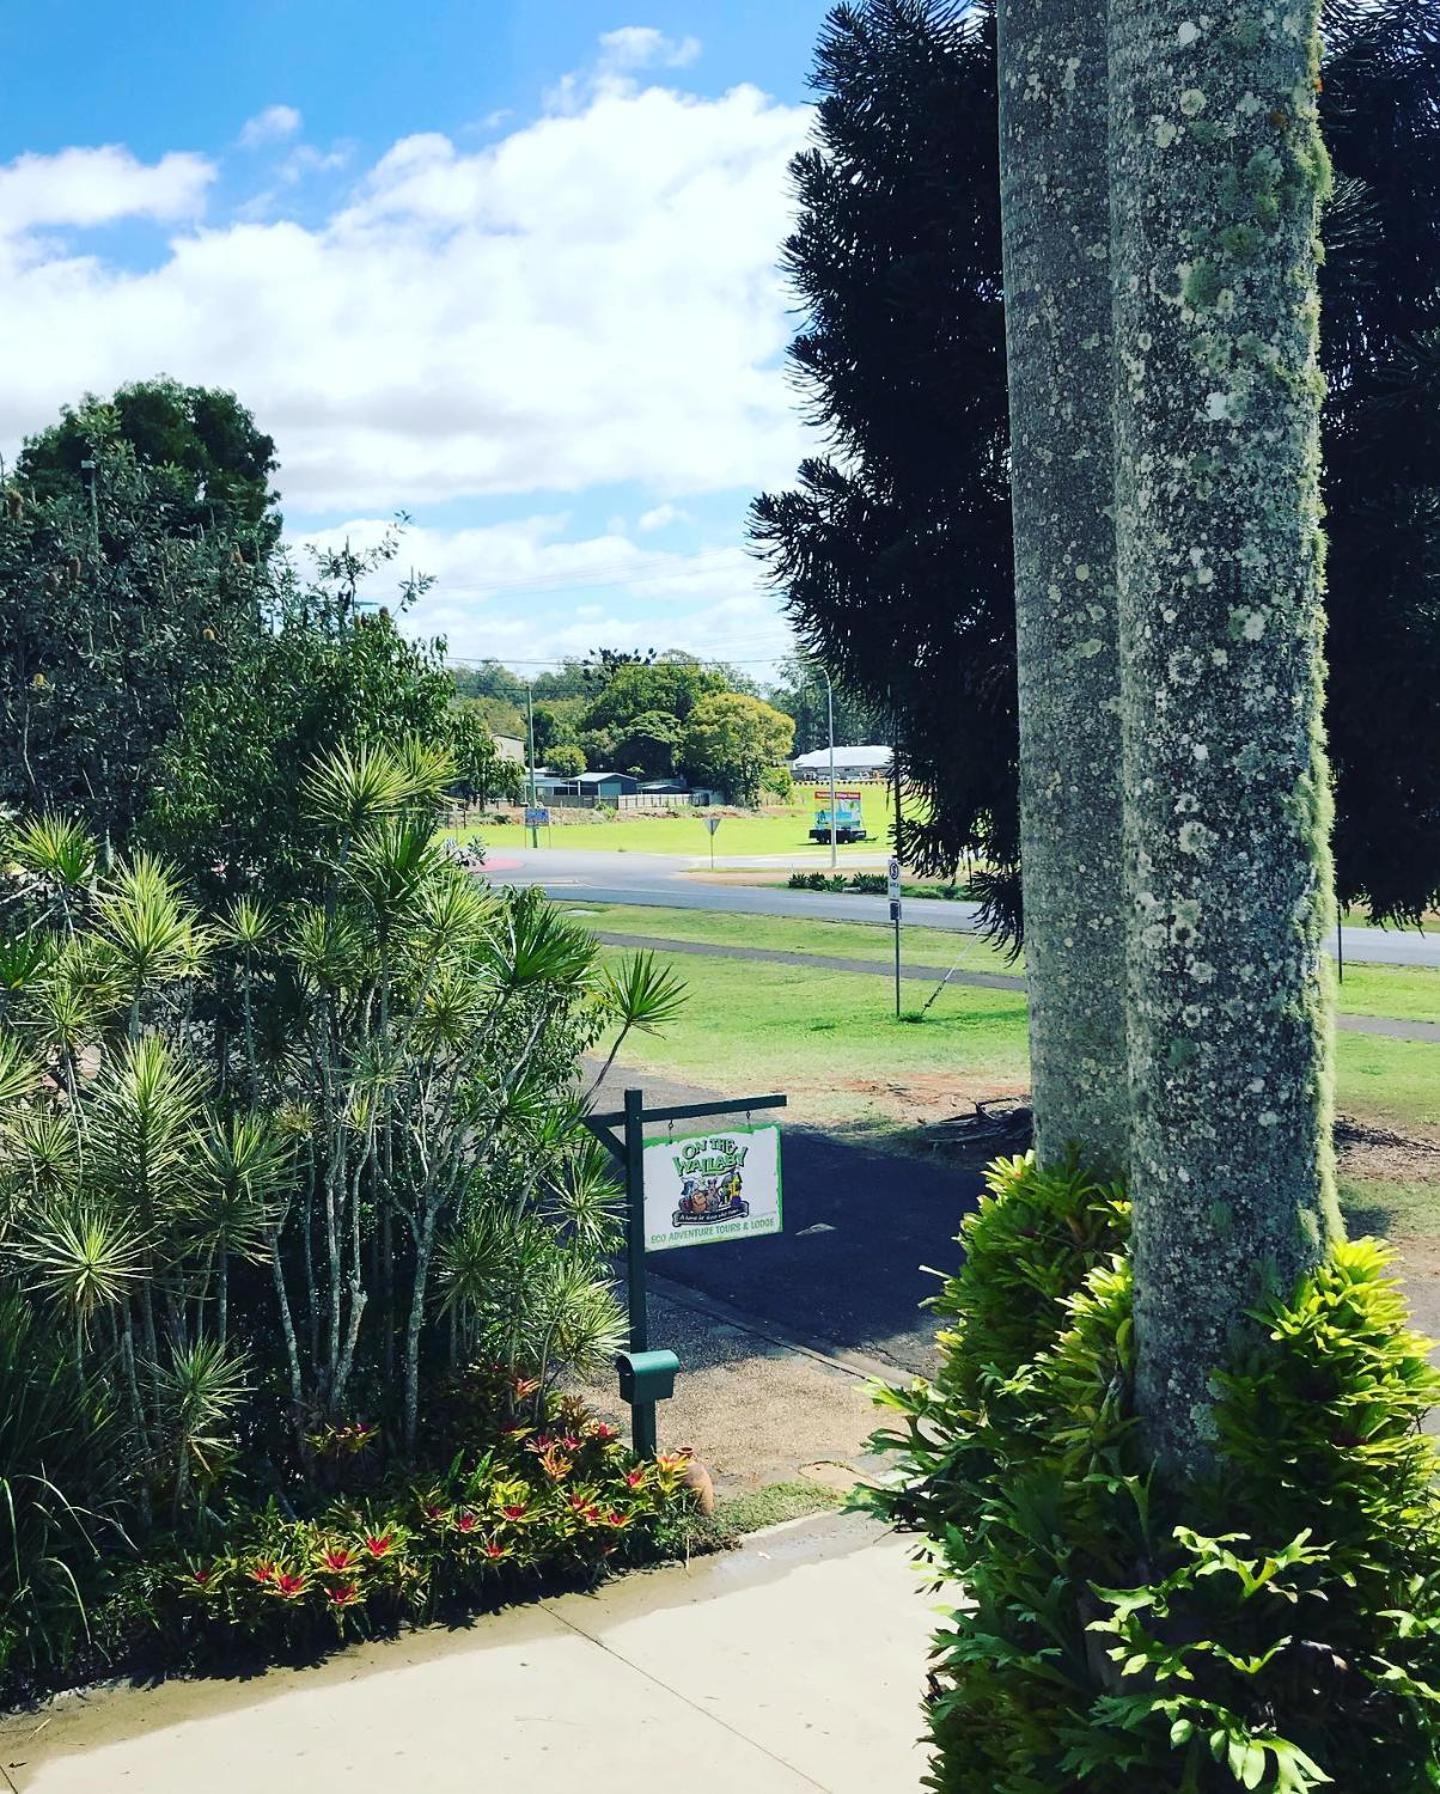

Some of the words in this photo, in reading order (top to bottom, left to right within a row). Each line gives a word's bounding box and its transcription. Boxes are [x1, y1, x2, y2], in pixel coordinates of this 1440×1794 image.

[672, 1146, 748, 1177] WALLABY
[682, 1140, 707, 1159] ON
[709, 1138, 738, 1155] THE
[650, 1233, 666, 1244] ECO
[668, 1226, 714, 1241] ADVENTURE
[715, 1222, 741, 1234] TOURS
[742, 1221, 749, 1230] &
[750, 1218, 775, 1230] LODGE
